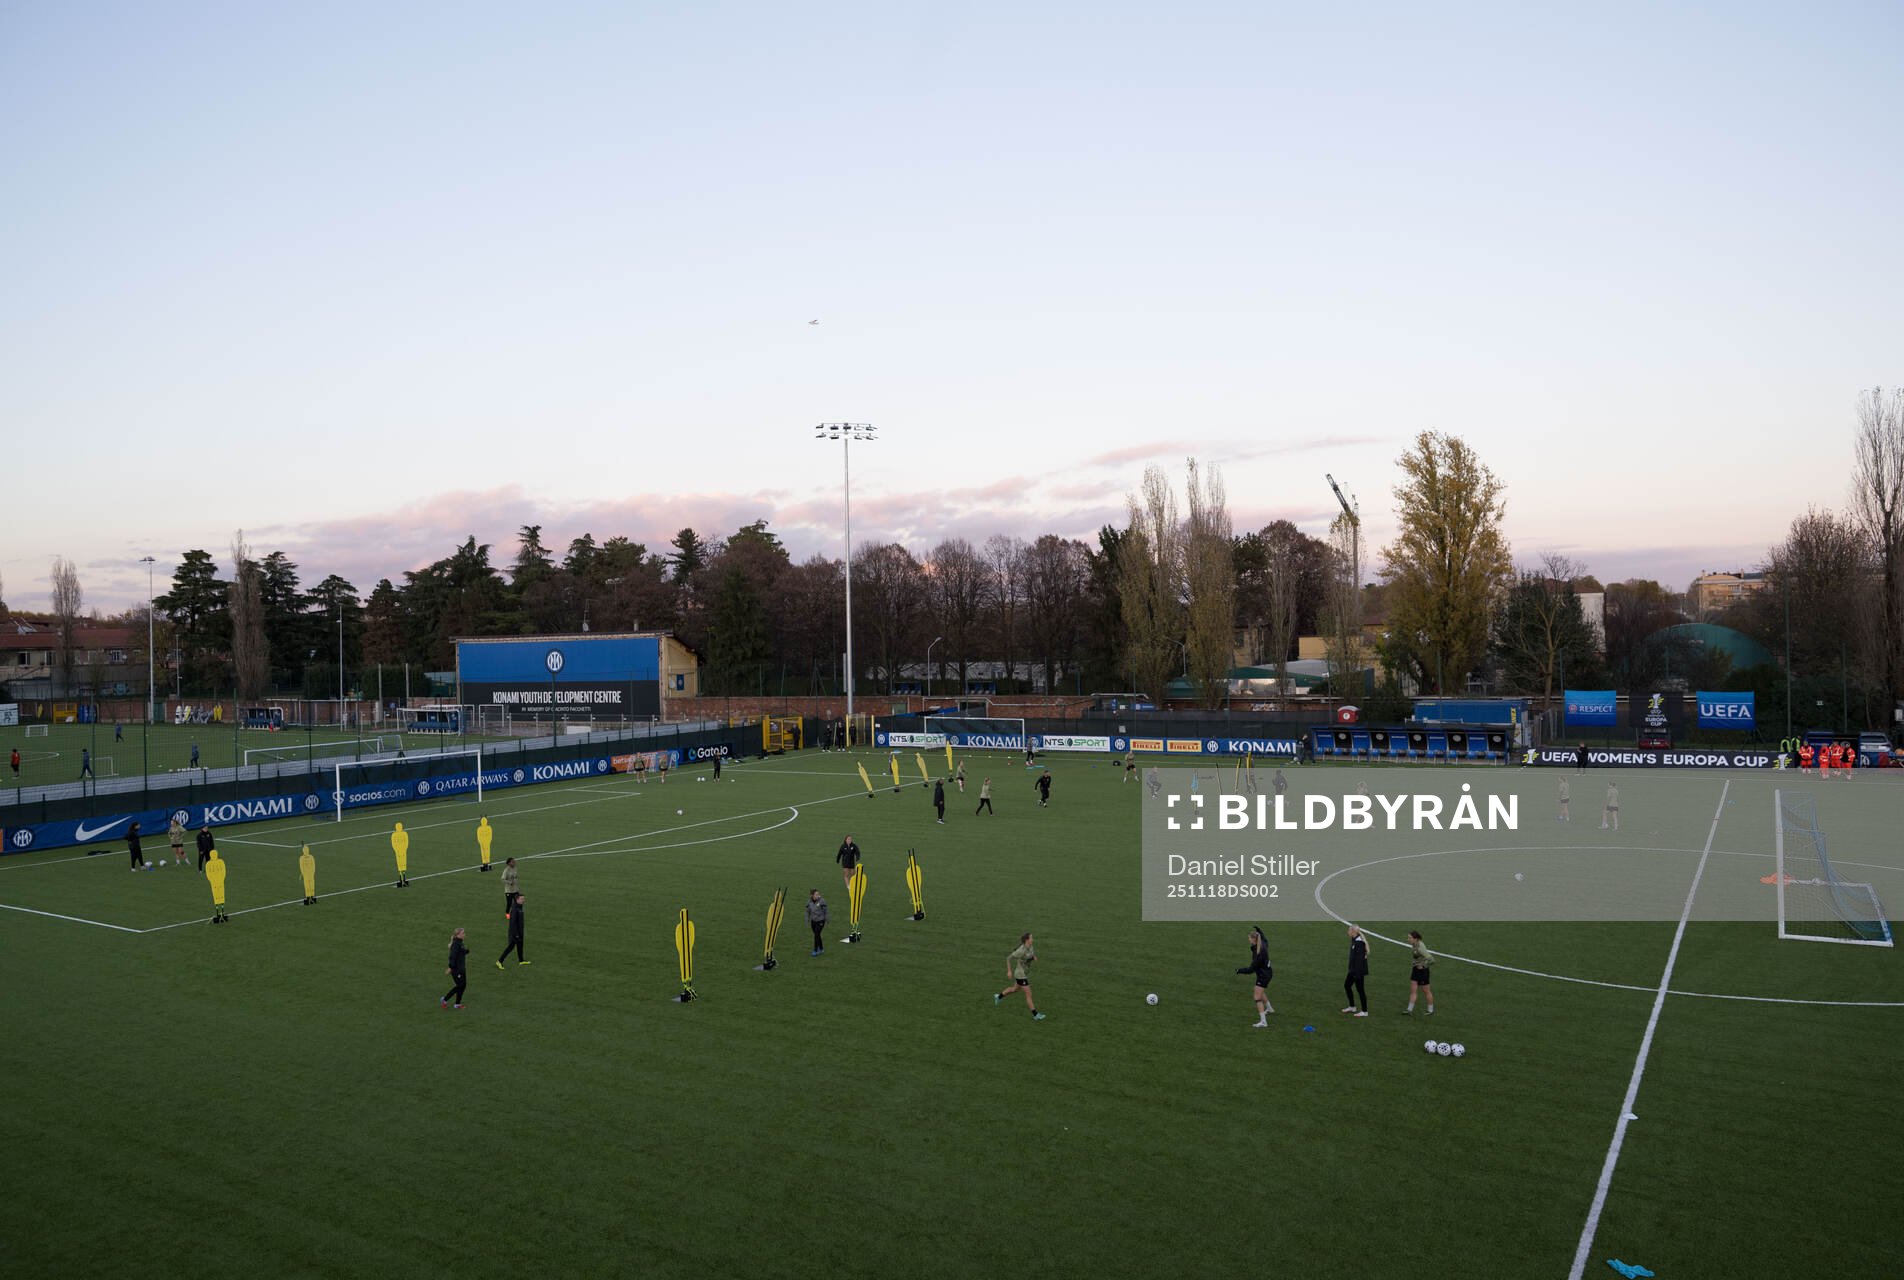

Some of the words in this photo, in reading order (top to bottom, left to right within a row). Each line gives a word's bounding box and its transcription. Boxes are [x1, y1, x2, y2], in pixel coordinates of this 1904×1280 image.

[493, 691, 519, 703] KONAMI
[520, 691, 542, 703] YOUTH
[594, 690, 622, 703] CENTRE
[1579, 705, 1613, 713] RESPECT
[1700, 703, 1751, 717] UEFA
[967, 735, 1022, 747] KONAMI
[1073, 738, 1108, 747] SPORT
[1132, 741, 1161, 749] PIRELLI
[1169, 741, 1200, 750] PIRELLI
[1229, 740, 1297, 754] KONAMI
[1541, 751, 1578, 762] UEFA
[1663, 753, 1729, 766] EUROPA
[1733, 755, 1769, 767] CUP
[533, 761, 590, 780] KONAMI
[435, 777, 467, 791] QATAR
[470, 773, 509, 787] ARWAYS
[204, 798, 292, 824] KONAMI
